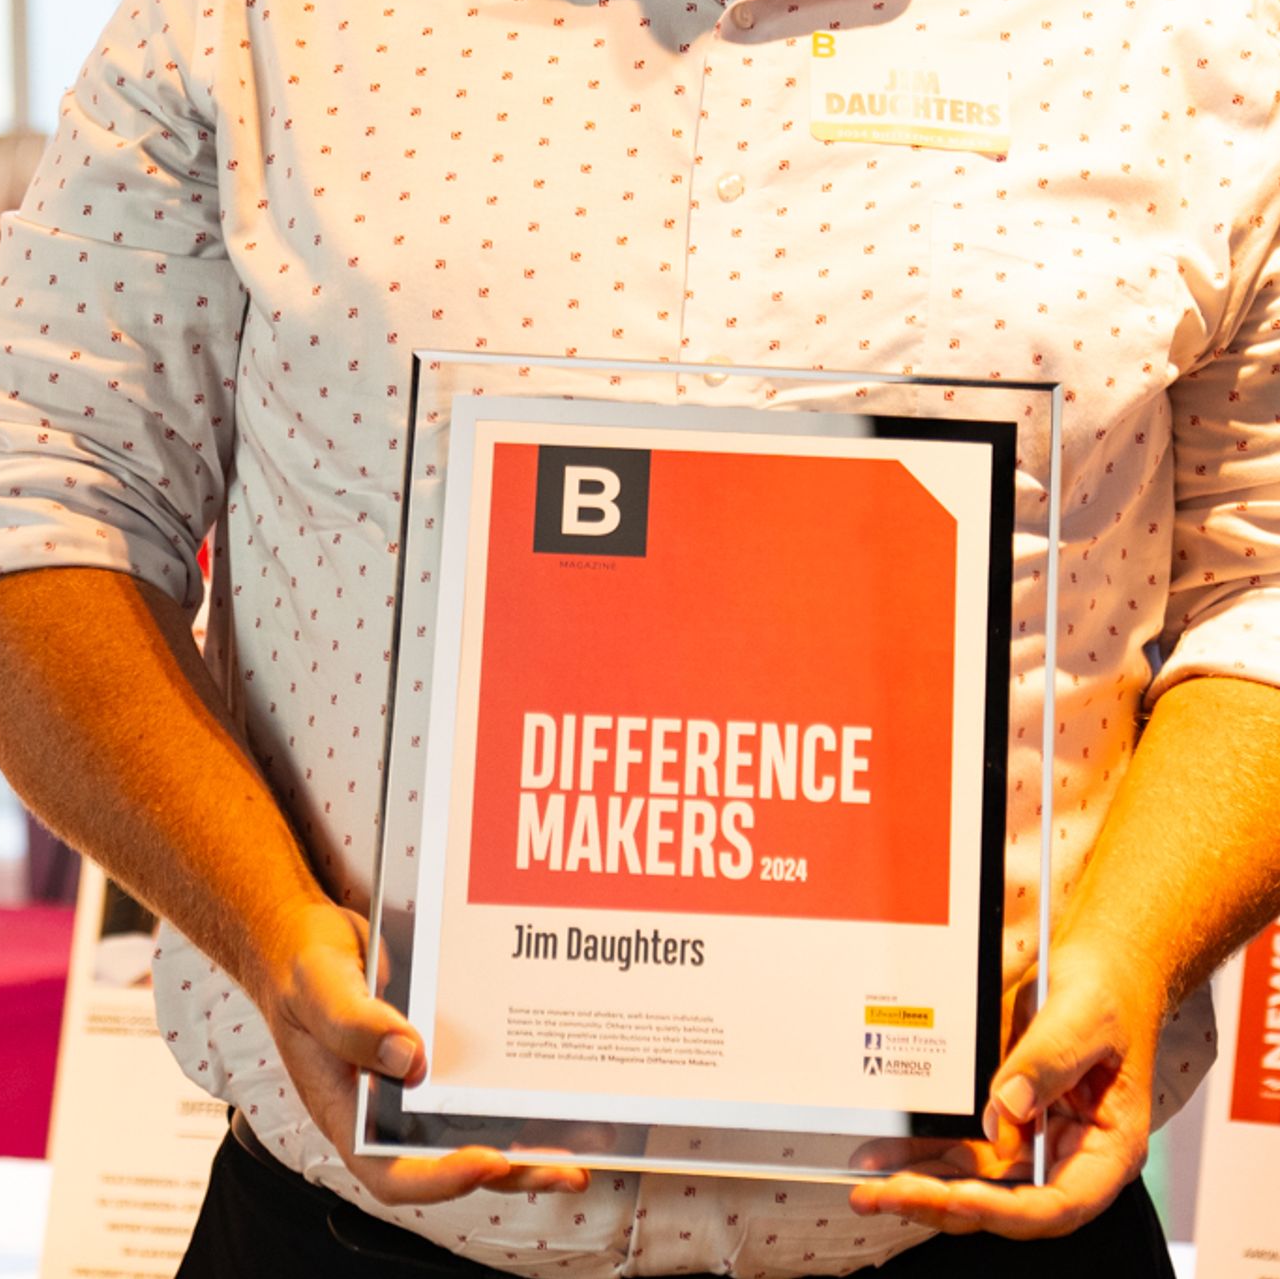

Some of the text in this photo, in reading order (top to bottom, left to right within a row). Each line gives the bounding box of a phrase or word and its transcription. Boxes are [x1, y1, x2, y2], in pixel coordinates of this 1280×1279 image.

[812, 31, 836, 58] B
[885, 68, 941, 95] JIM
[825, 92, 1002, 126] DAUGHTERS
[561, 465, 621, 537] B
[559, 560, 617, 570] MAGAZINE
[521, 712, 873, 804] DIFFERENCE
[516, 792, 808, 882] MAKERS 2024
[512, 925, 705, 971] Jim Daughters
[886, 1060, 931, 1071] ARNOLD
